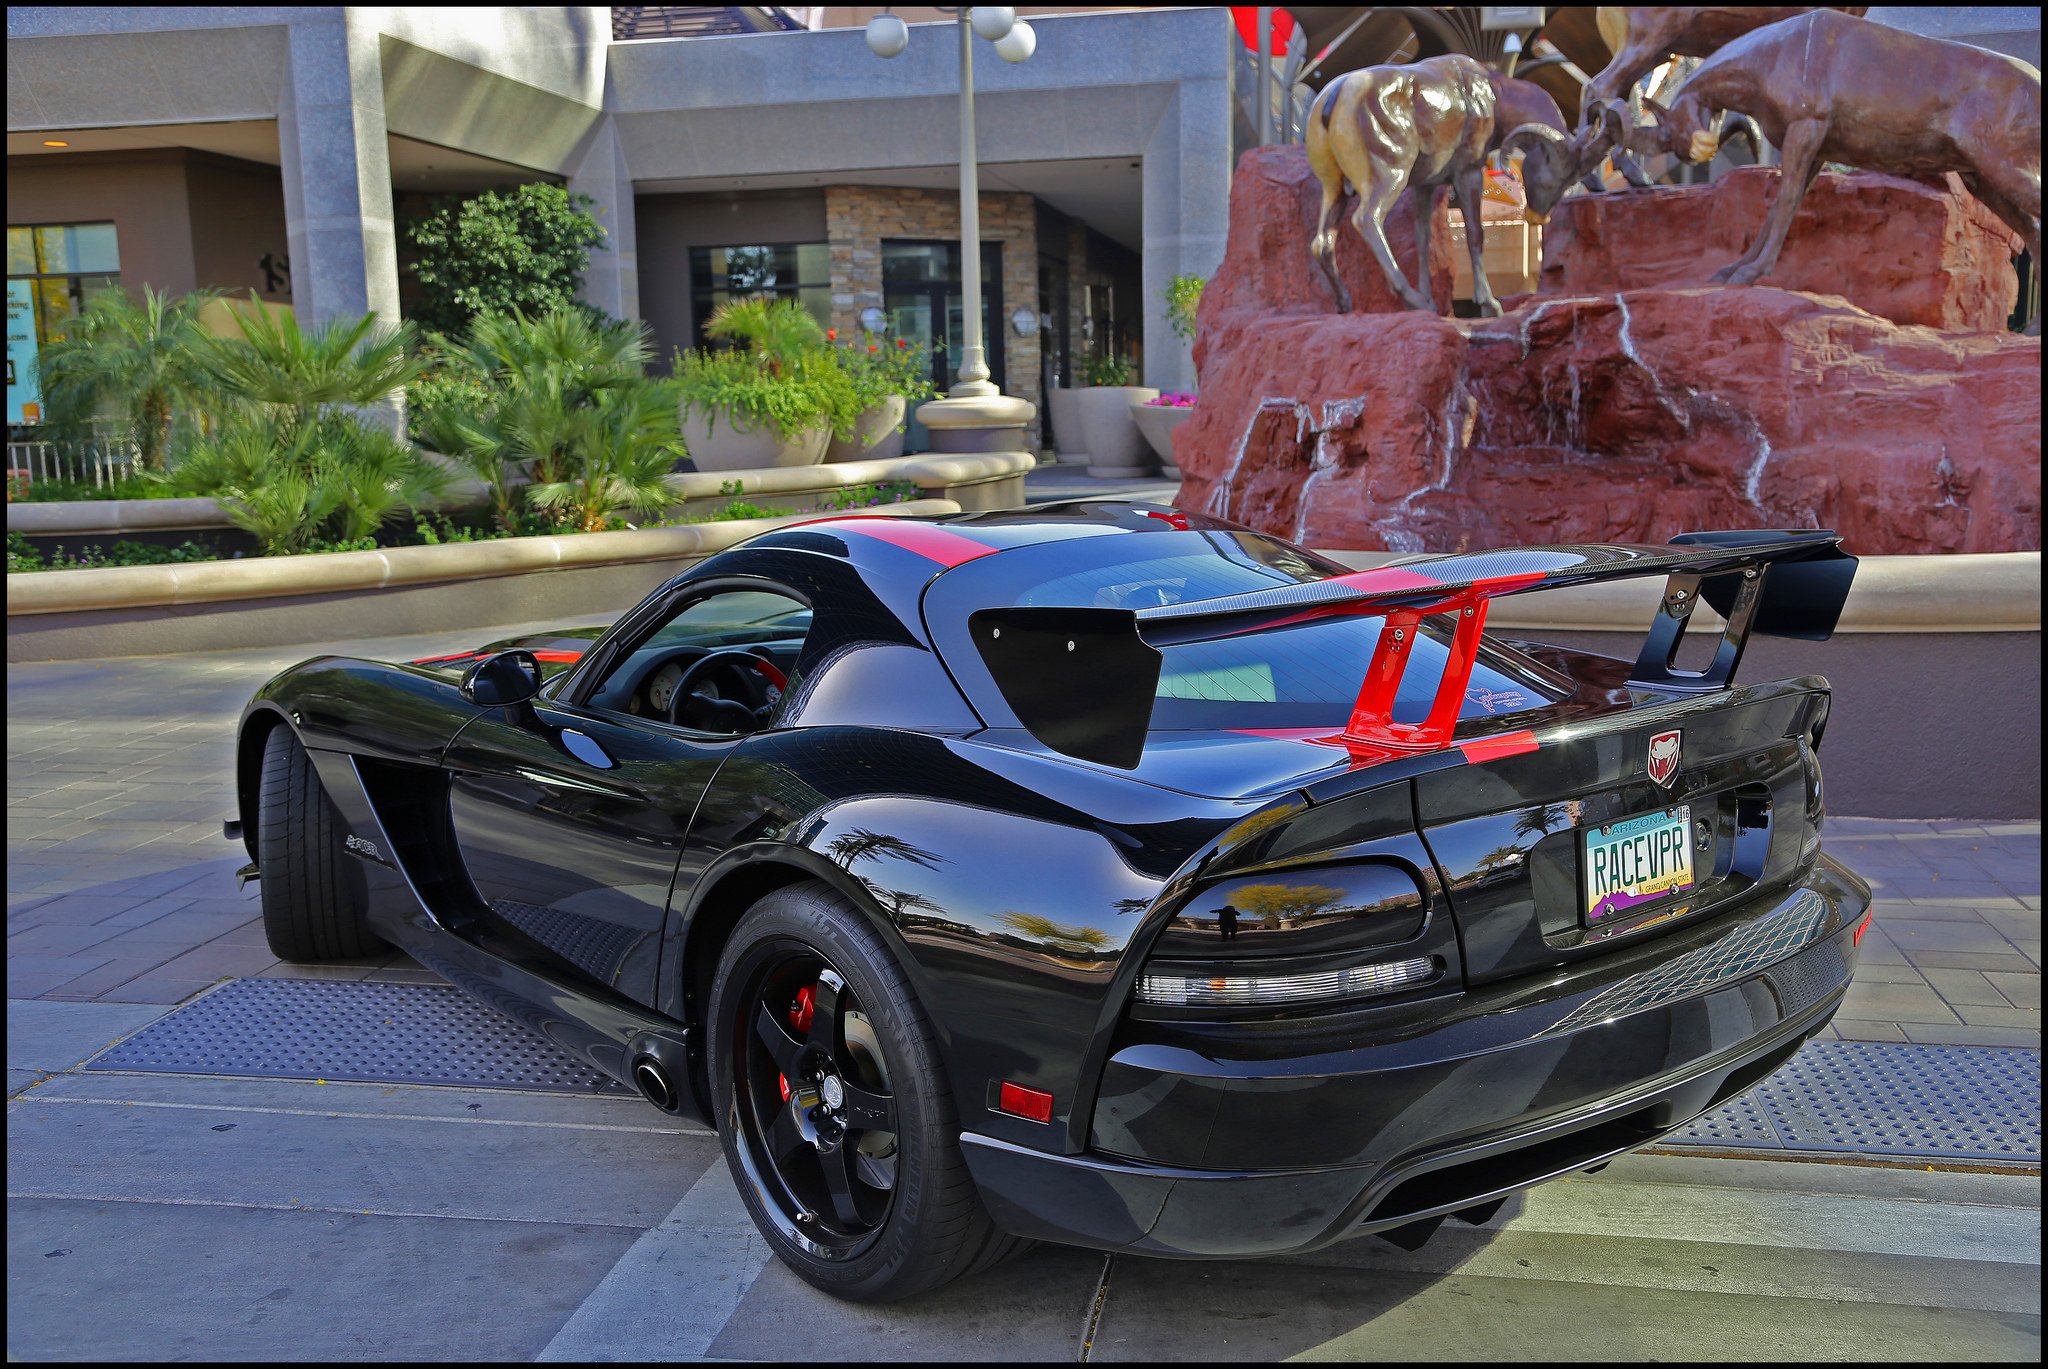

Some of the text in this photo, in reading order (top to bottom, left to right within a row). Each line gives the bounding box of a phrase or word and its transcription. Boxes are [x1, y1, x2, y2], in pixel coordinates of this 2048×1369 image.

[1682, 808, 1690, 819] 16
[1611, 814, 1666, 835] ARIZONA
[1594, 826, 1684, 896] RACEVPR
[1645, 883, 1660, 894] GRAND
[1677, 873, 1689, 884] STATE
